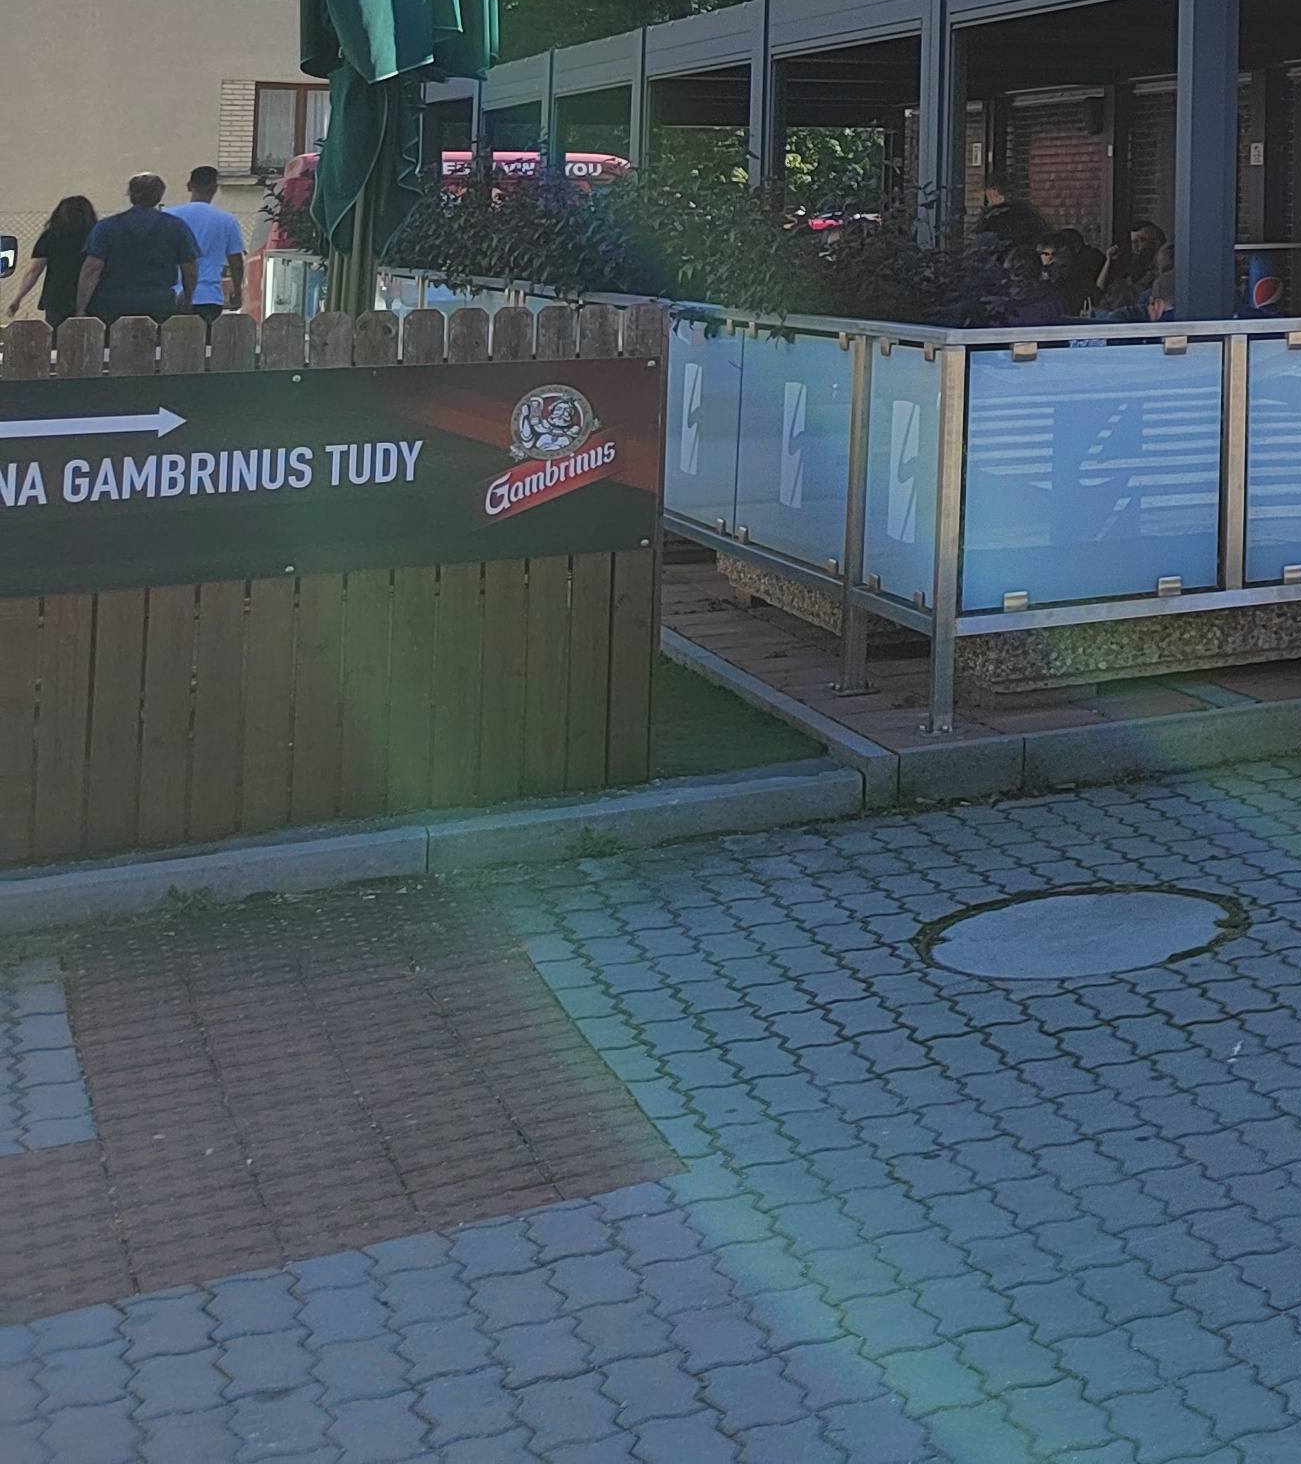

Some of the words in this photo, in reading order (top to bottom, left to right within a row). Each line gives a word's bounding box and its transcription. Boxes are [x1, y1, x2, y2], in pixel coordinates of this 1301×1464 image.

[63, 445, 313, 503] GAMBRINUS
[326, 440, 423, 486] TUDY
[485, 442, 616, 515] Gambrinus
